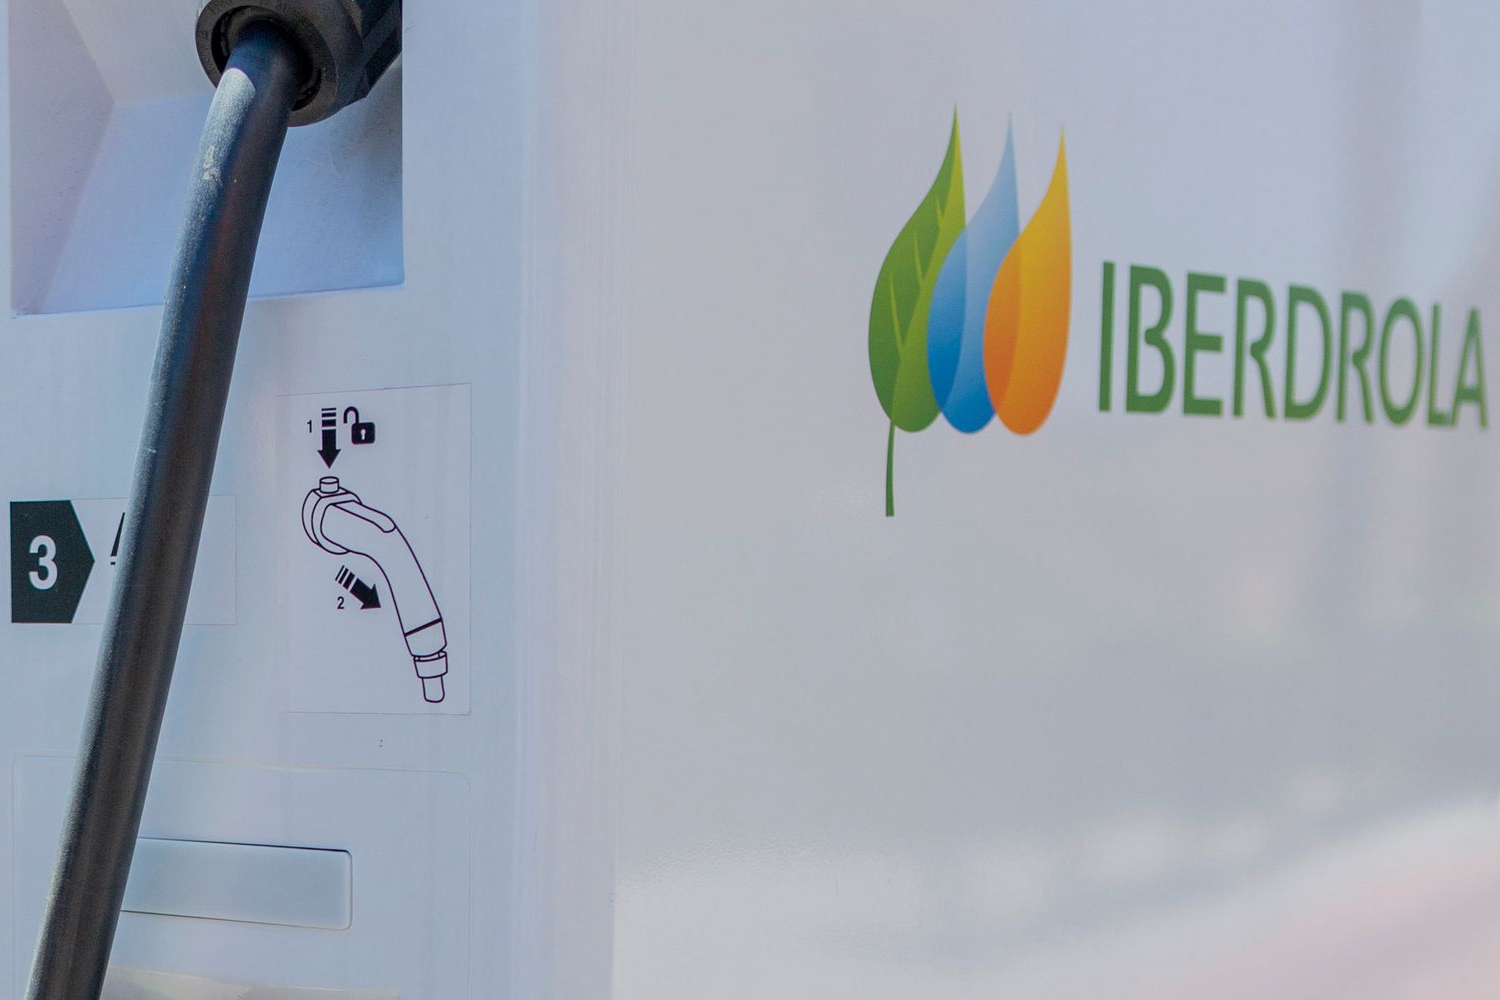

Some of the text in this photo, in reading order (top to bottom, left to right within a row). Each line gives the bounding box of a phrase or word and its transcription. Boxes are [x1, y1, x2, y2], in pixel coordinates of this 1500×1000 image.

[1097, 260, 1489, 430] IBERDROLA
[306, 419, 313, 433] 1
[27, 534, 58, 590] 3
[336, 596, 345, 610] 2
